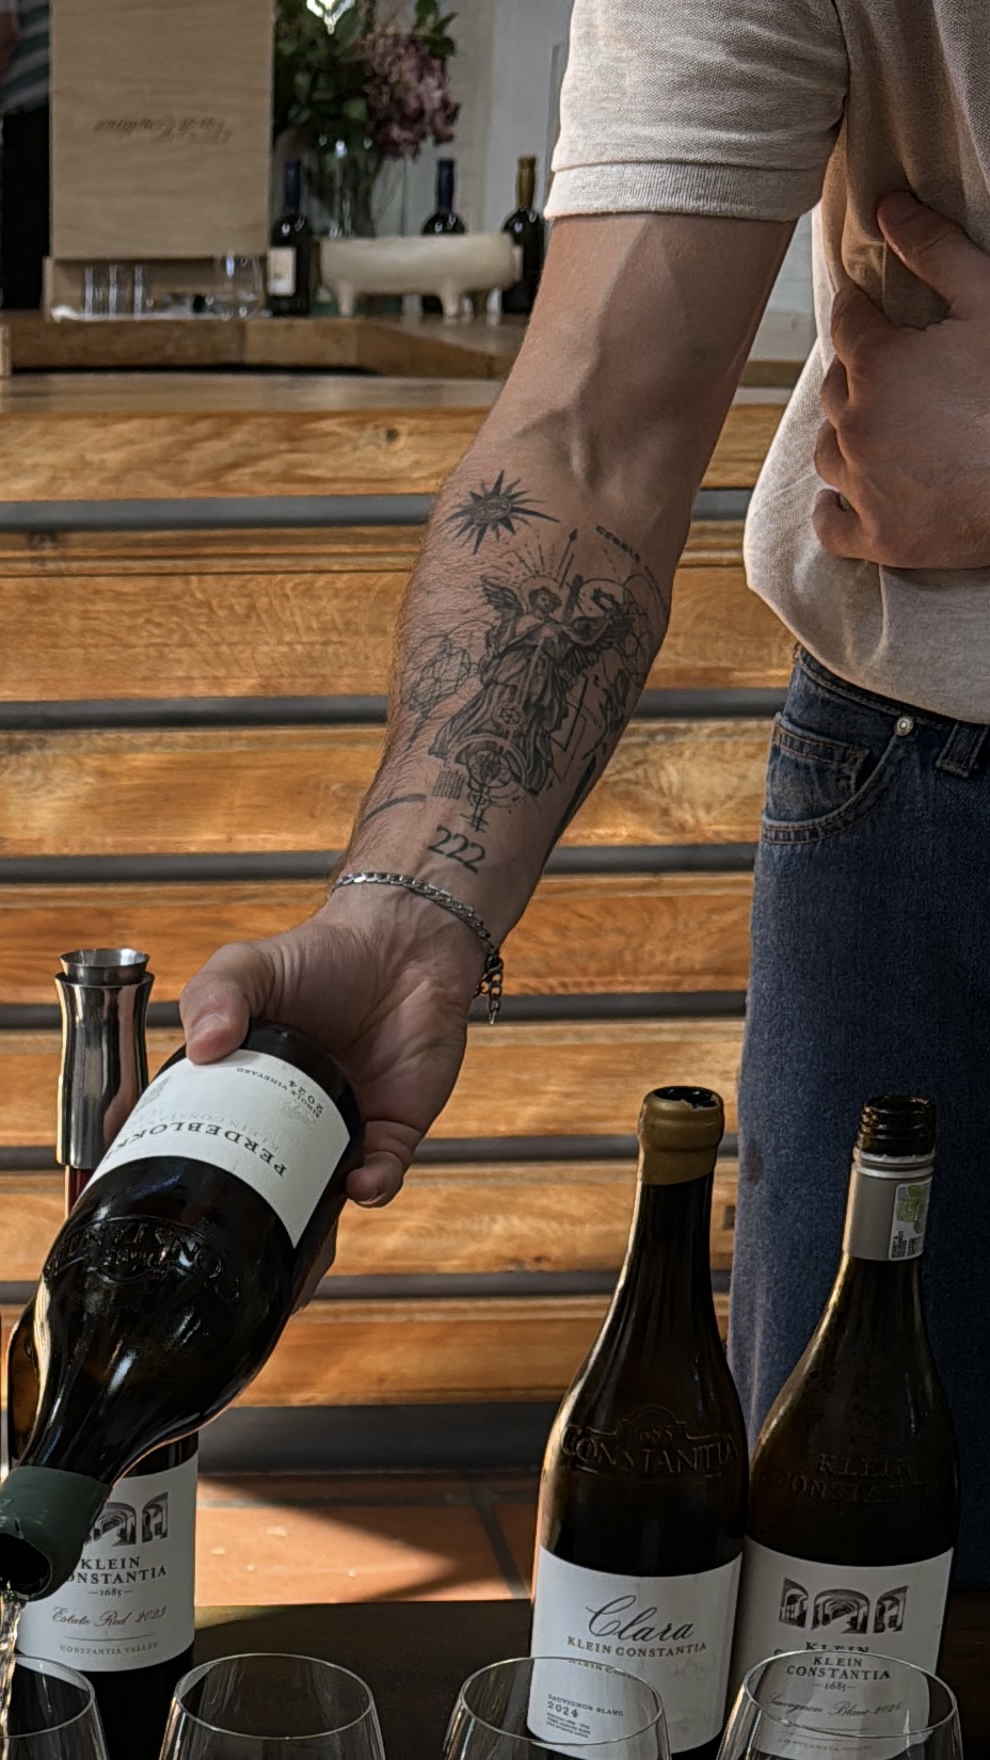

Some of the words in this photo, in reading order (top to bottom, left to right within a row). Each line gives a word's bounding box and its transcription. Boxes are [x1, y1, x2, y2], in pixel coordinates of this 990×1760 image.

[427, 825, 486, 874] 222
[236, 1067, 288, 1092] VINEYARD
[289, 1080, 324, 1113] 2024
[291, 1089, 322, 1119] SINGLE
[80, 1556, 141, 1571] KLEIN
[67, 1565, 167, 1585] ONSTANTIA
[52, 1606, 91, 1623] Estate
[94, 1610, 132, 1627] Red
[135, 1605, 167, 1624] 2023
[585, 1595, 695, 1642] Clara
[61, 1644, 122, 1655] CONSTANTIA
[125, 1641, 159, 1653] VALLEY
[567, 1635, 612, 1655] KLEIN
[615, 1641, 707, 1658] CONSTANTIA
[786, 1665, 891, 1681] CONSTANTIA
[812, 1656, 863, 1668] KLEIN
[547, 1701, 578, 1718] 2024
[548, 1693, 593, 1711] SAUVIGNON
[596, 1706, 624, 1717] BLANC
